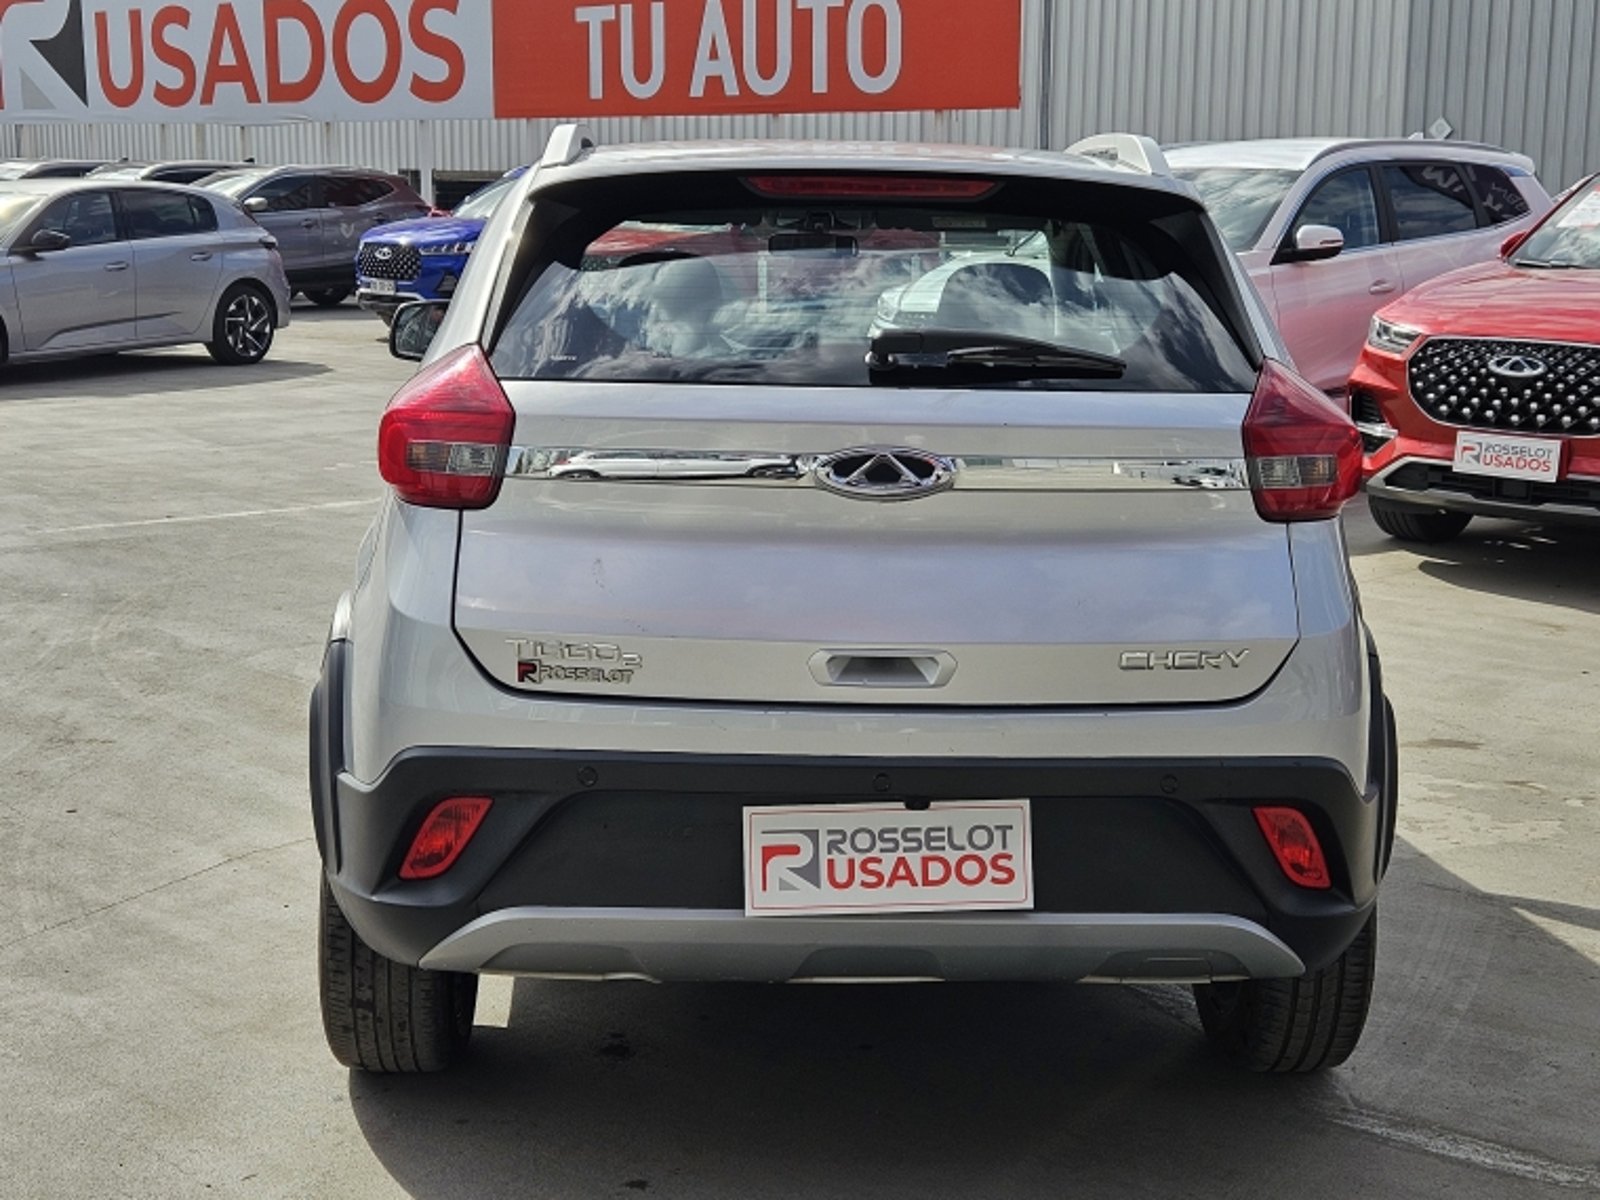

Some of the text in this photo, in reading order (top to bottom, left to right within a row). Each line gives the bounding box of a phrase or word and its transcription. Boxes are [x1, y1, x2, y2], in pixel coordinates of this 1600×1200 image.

[95, 0, 465, 108] USADOS
[575, 0, 902, 99] TU AUTO
[1482, 454, 1551, 473] USADOS
[1484, 444, 1553, 458] ROSSELOT
[1119, 648, 1249, 670] CHERY
[540, 665, 634, 684] ROSSELOT
[826, 825, 1013, 855] ROSSELOT
[826, 853, 1016, 889] USADOS
